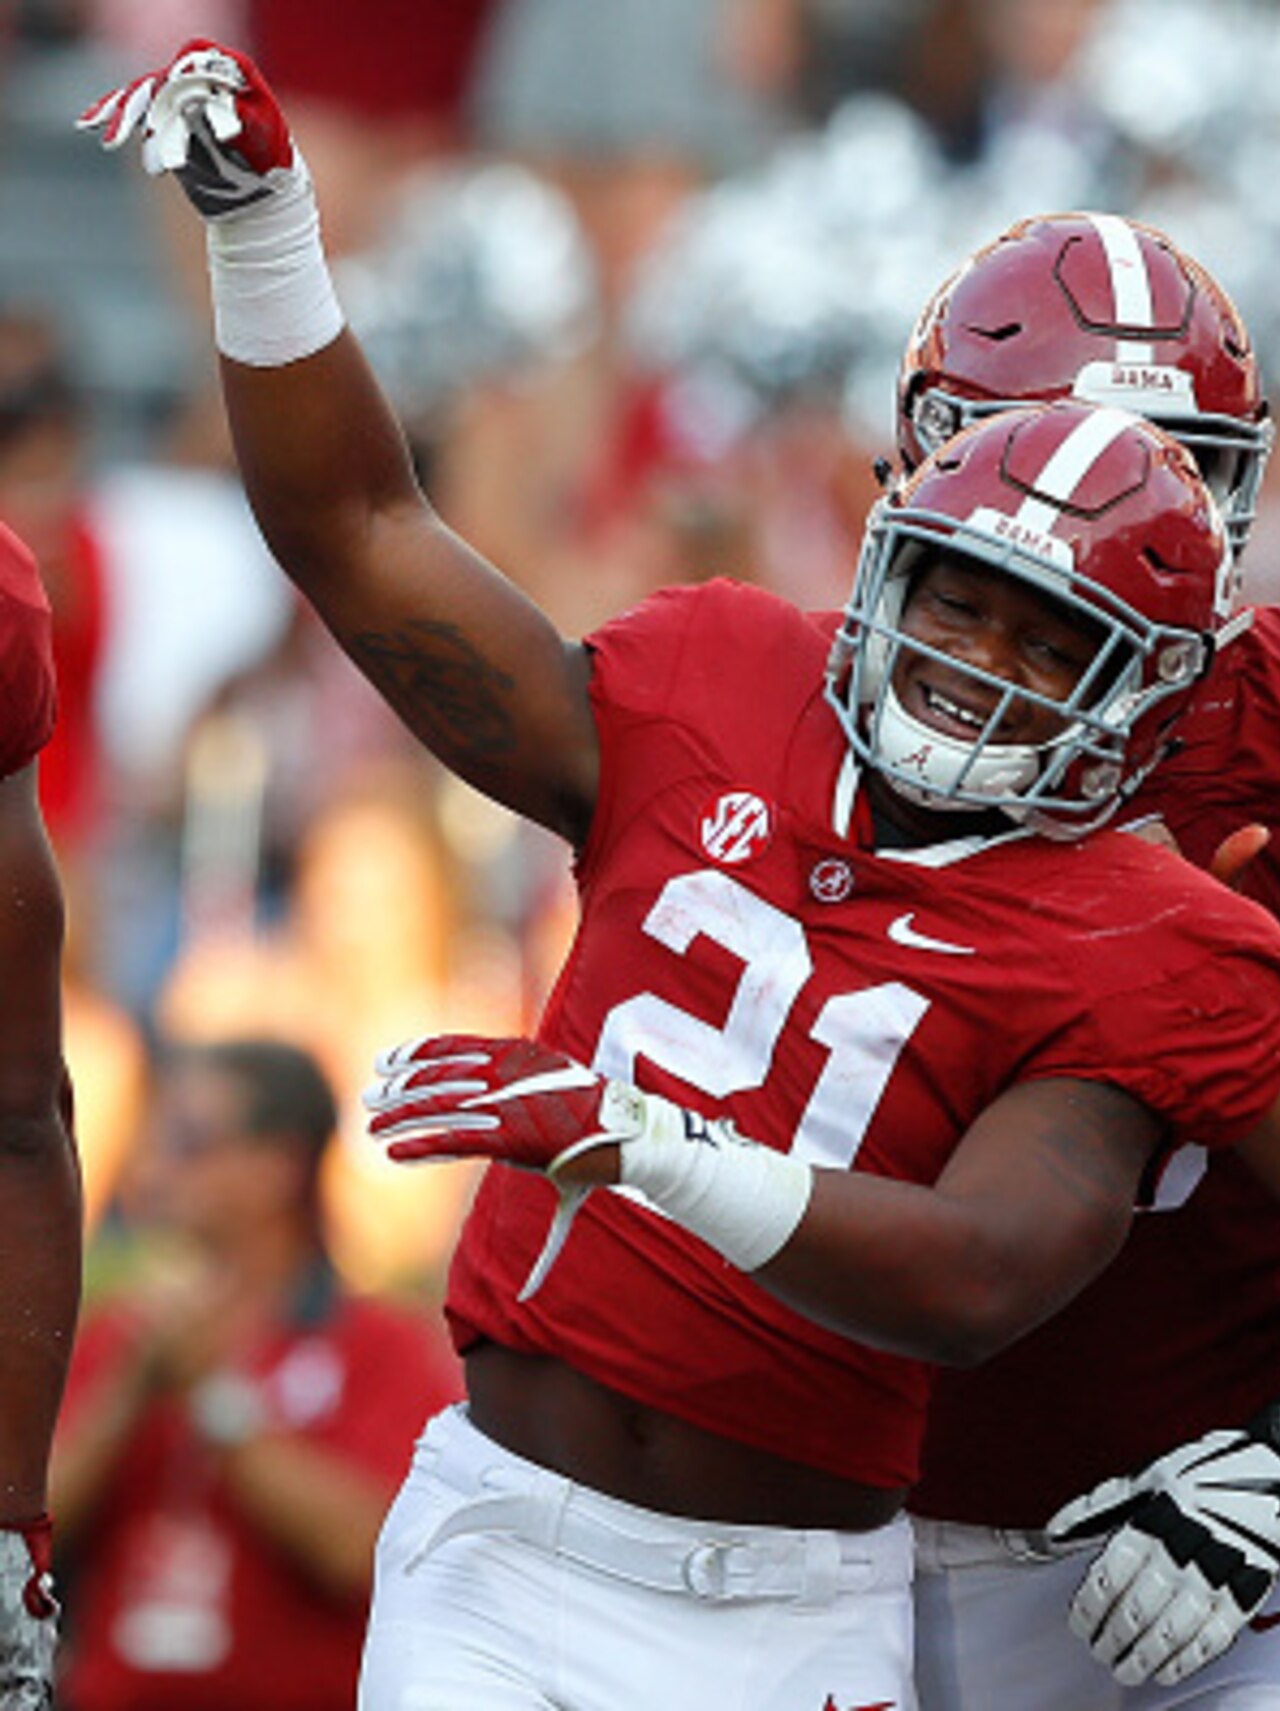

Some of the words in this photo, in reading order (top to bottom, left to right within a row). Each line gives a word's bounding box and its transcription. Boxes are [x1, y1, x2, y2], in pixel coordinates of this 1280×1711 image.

[1110, 368, 1174, 391] BAMA
[994, 516, 1054, 557] BAMA
[702, 792, 768, 863] SEC
[590, 869, 933, 1190] 21
